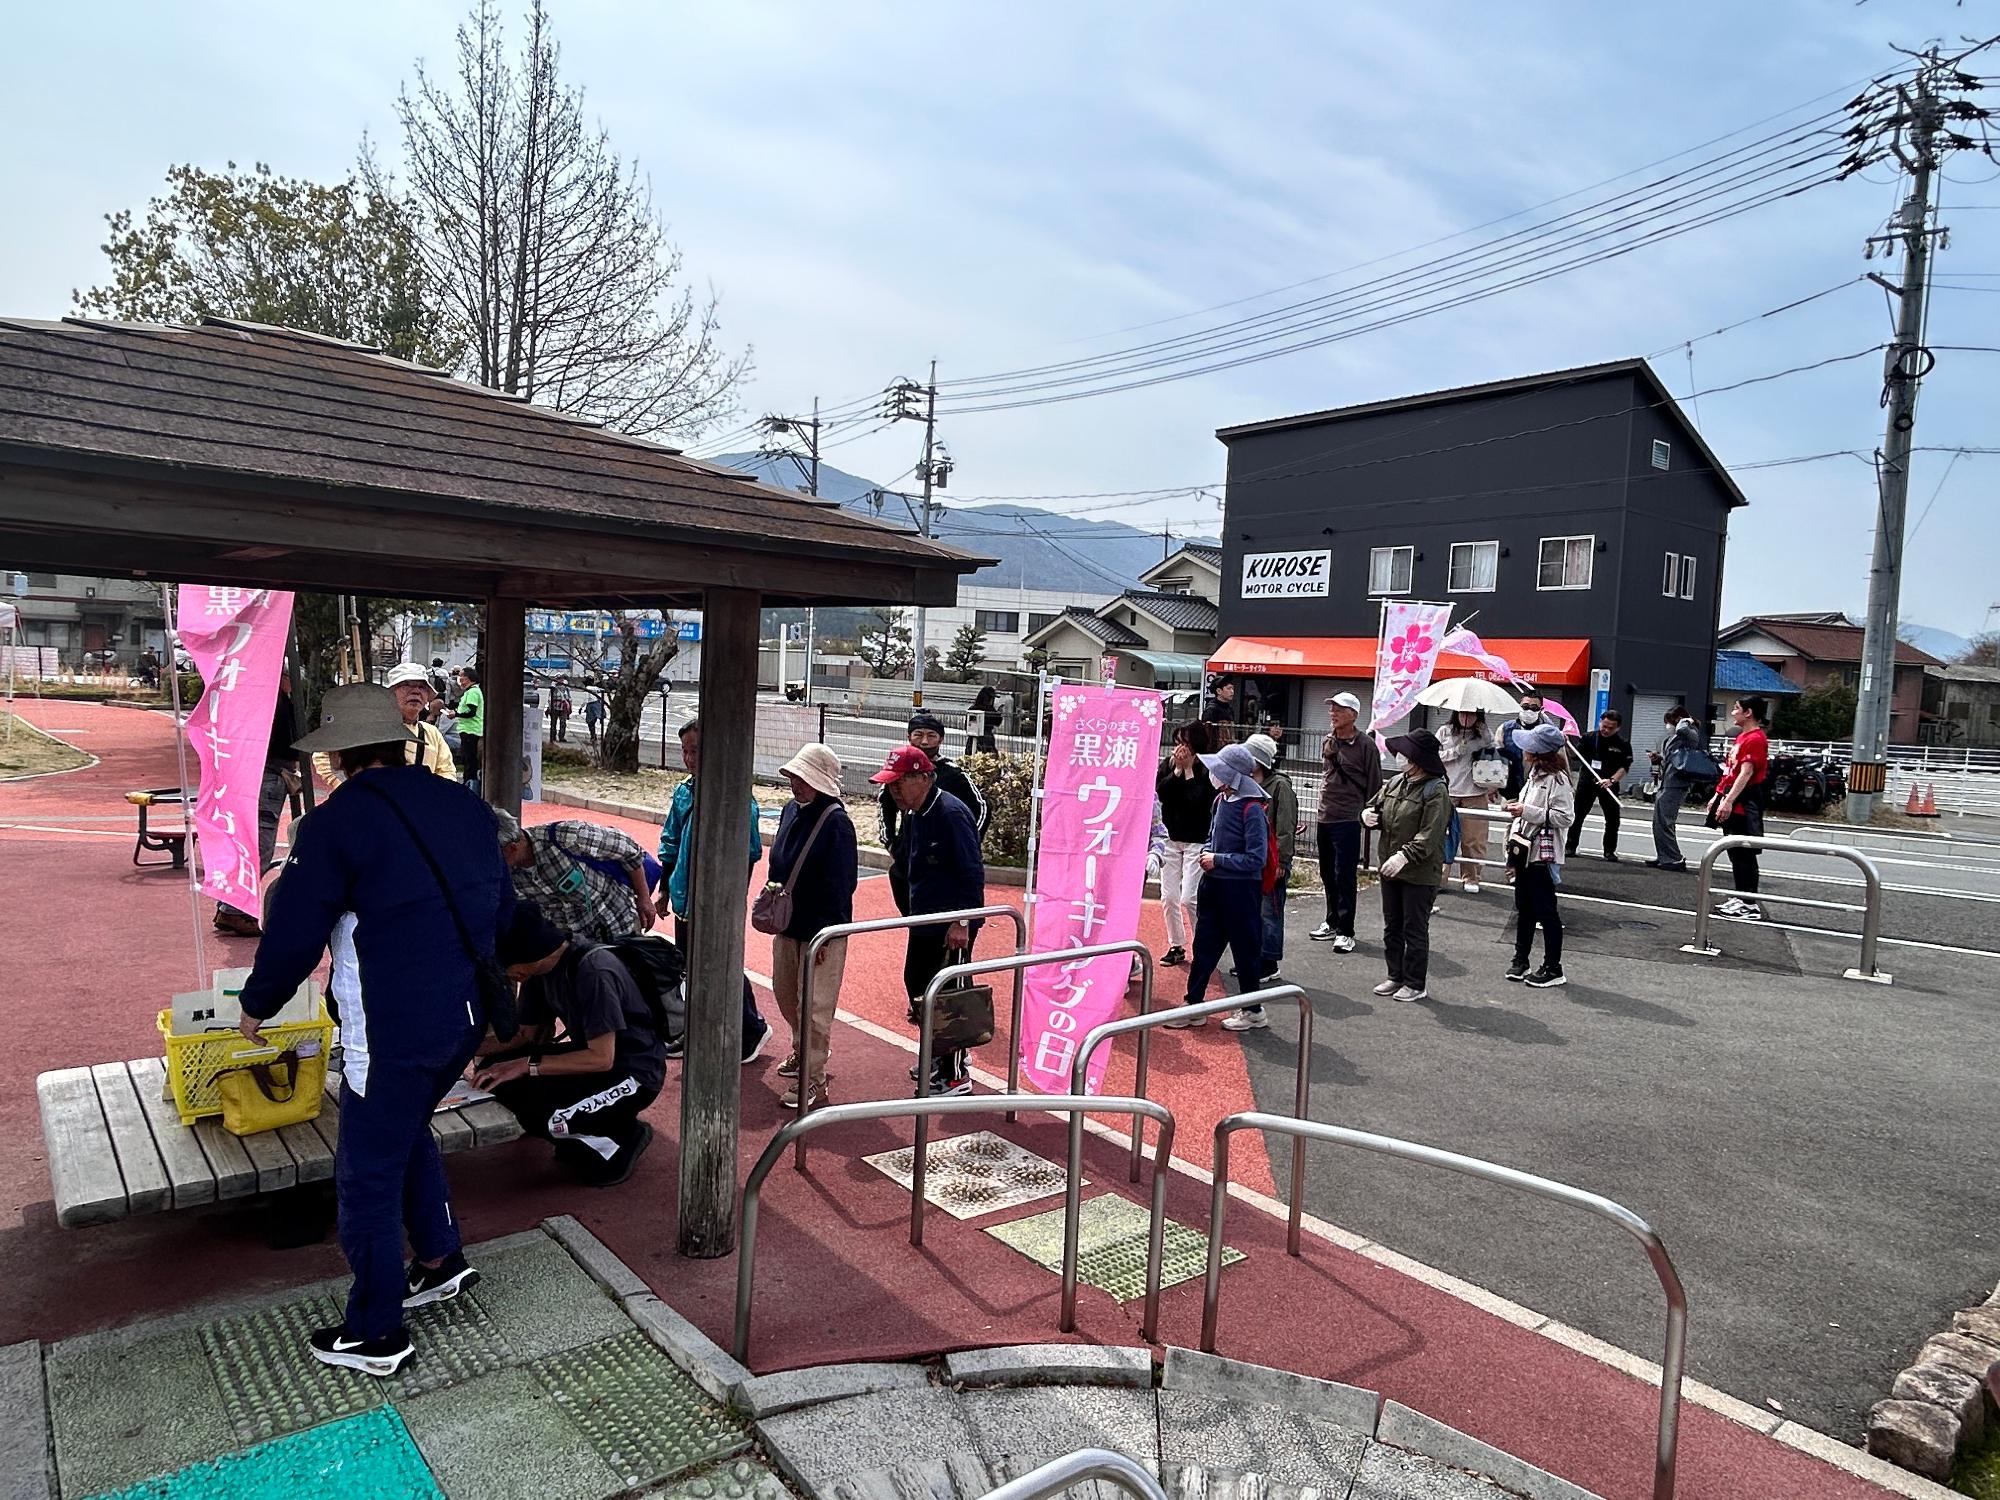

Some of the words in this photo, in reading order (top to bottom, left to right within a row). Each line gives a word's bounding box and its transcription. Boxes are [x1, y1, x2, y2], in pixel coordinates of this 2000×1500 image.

[1246, 555, 1327, 579] KUROSE
[1245, 583, 1283, 594] MOTOR
[1287, 582, 1325, 593] CYCLE
[1074, 717, 1141, 733] さくらのまち
[1068, 733, 1138, 769] 黒瀬
[1034, 775, 1124, 1078] ウォーキングの日
